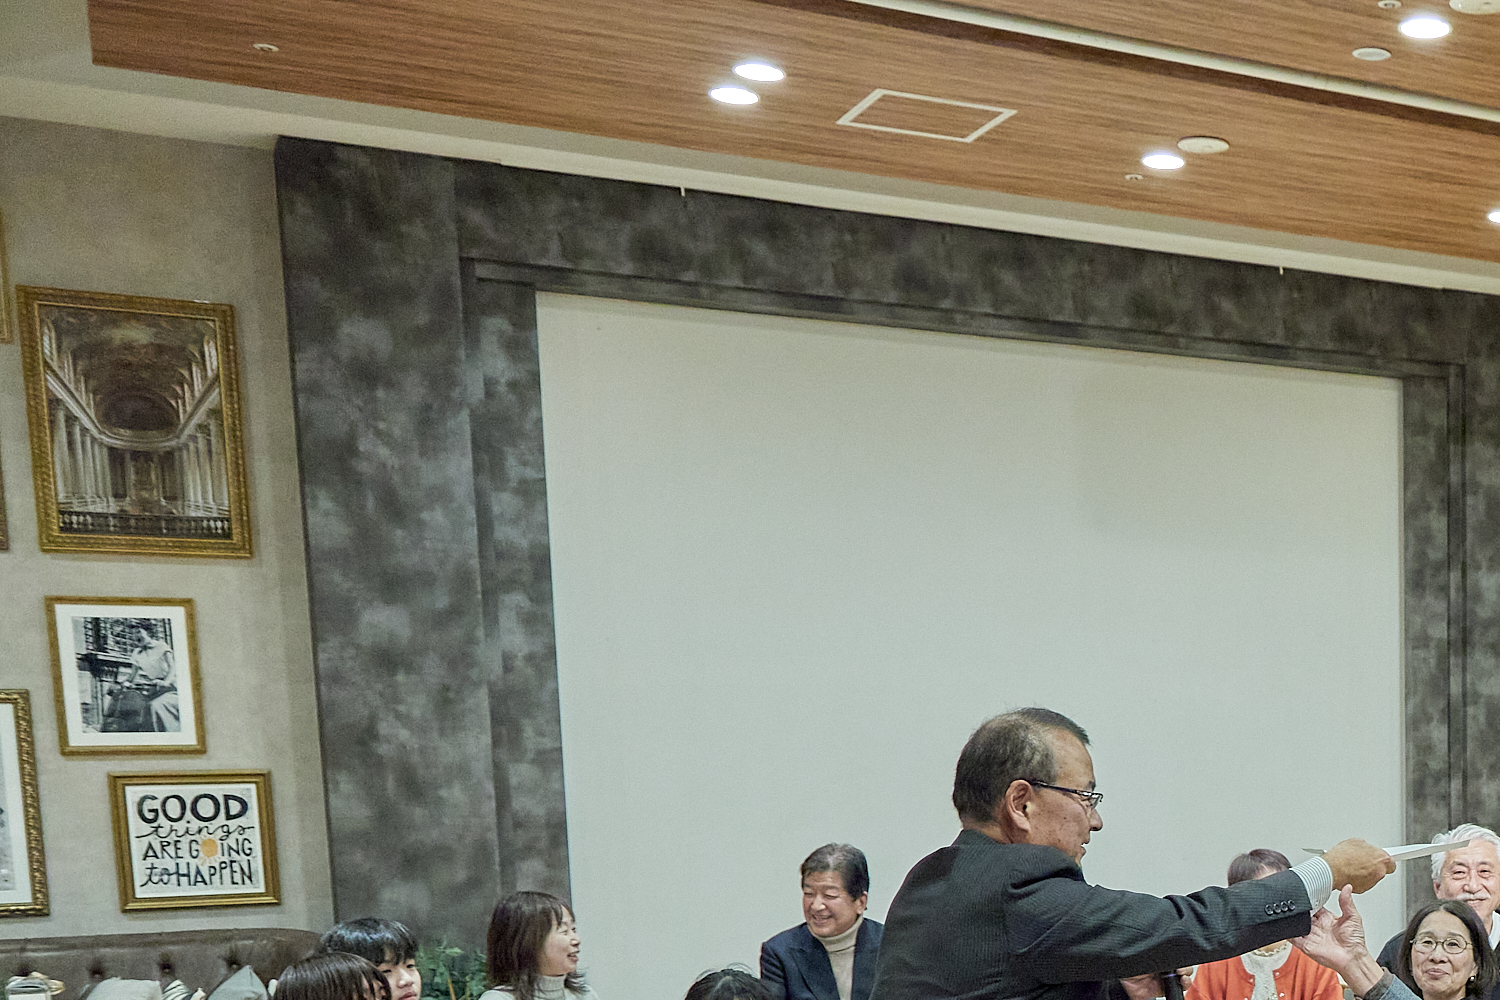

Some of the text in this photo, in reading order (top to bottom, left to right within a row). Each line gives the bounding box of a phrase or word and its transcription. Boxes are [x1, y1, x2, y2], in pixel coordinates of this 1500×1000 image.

[137, 793, 249, 824] GOOD
[142, 840, 184, 861] ARE
[140, 859, 254, 887] to HAPPEN
